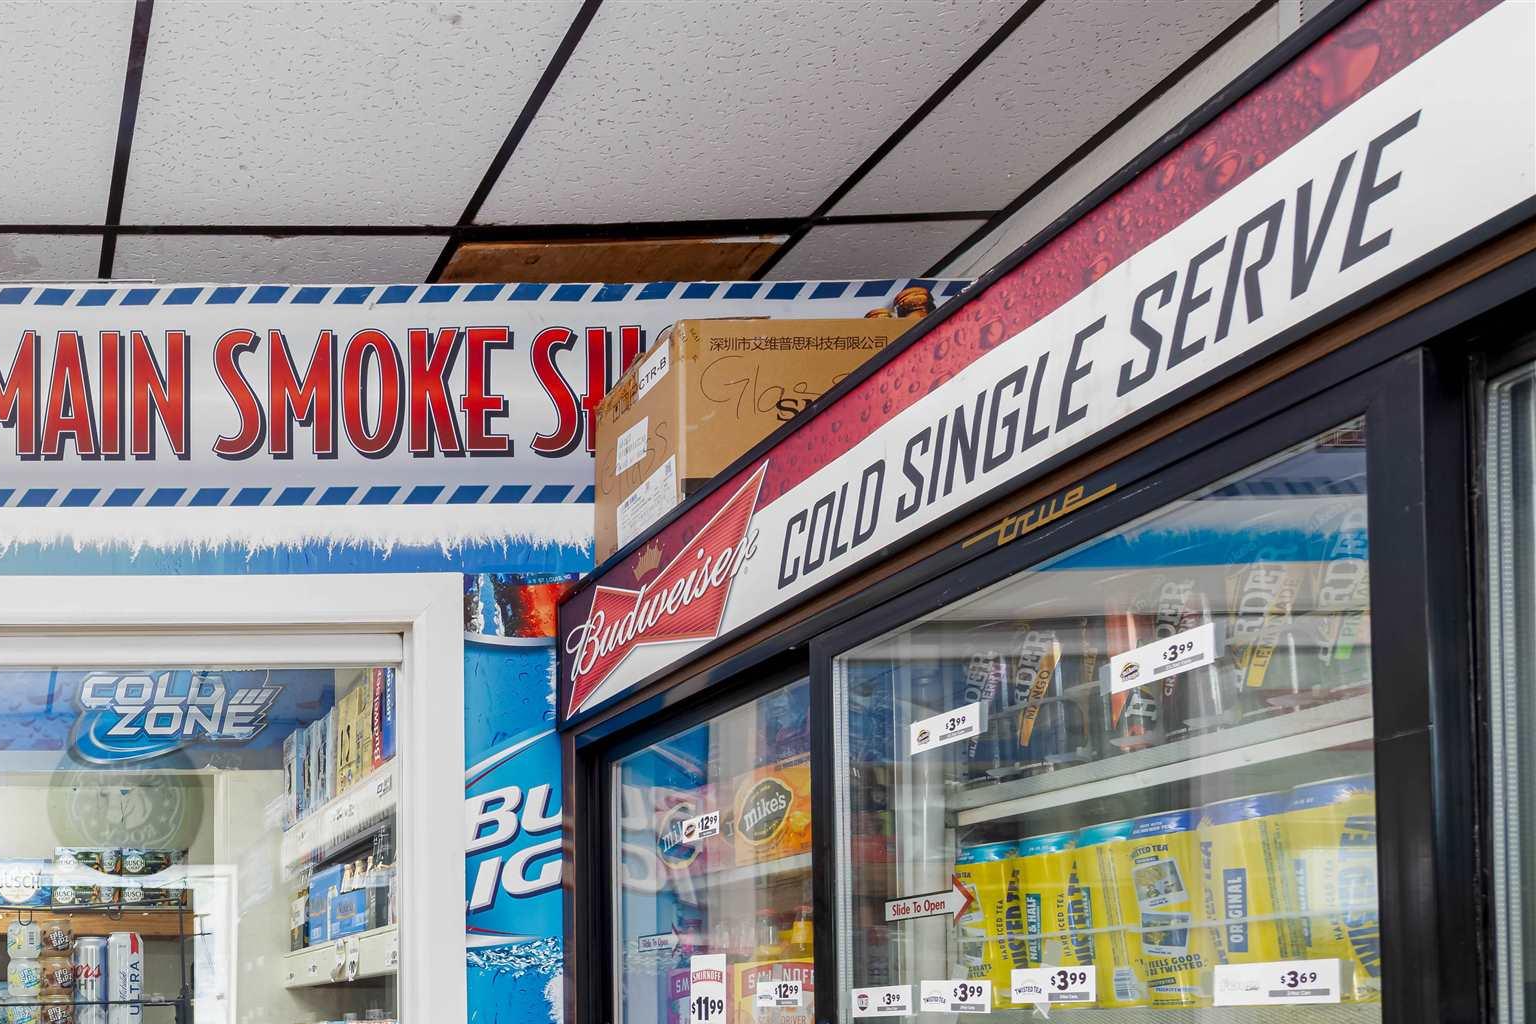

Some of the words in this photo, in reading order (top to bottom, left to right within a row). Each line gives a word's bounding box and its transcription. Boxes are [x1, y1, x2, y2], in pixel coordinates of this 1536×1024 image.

[778, 461, 885, 591] COLD
[894, 314, 1108, 522] SINGLE
[1116, 108, 1422, 397] SERVE
[213, 325, 514, 459] SMOKE
[530, 325, 647, 455] SH
[566, 528, 759, 682] Budweiser
[81, 670, 224, 710] COLD
[107, 704, 270, 738] ZONE
[464, 784, 563, 854] BU
[743, 791, 787, 833] mike's
[891, 902, 911, 918] Slide
[912, 902, 922, 915] To
[924, 898, 946, 914] Open
[692, 969, 723, 984] SMIRNOFF
[1171, 953, 1201, 966] GOOD
[129, 960, 140, 1016] ULTRA
